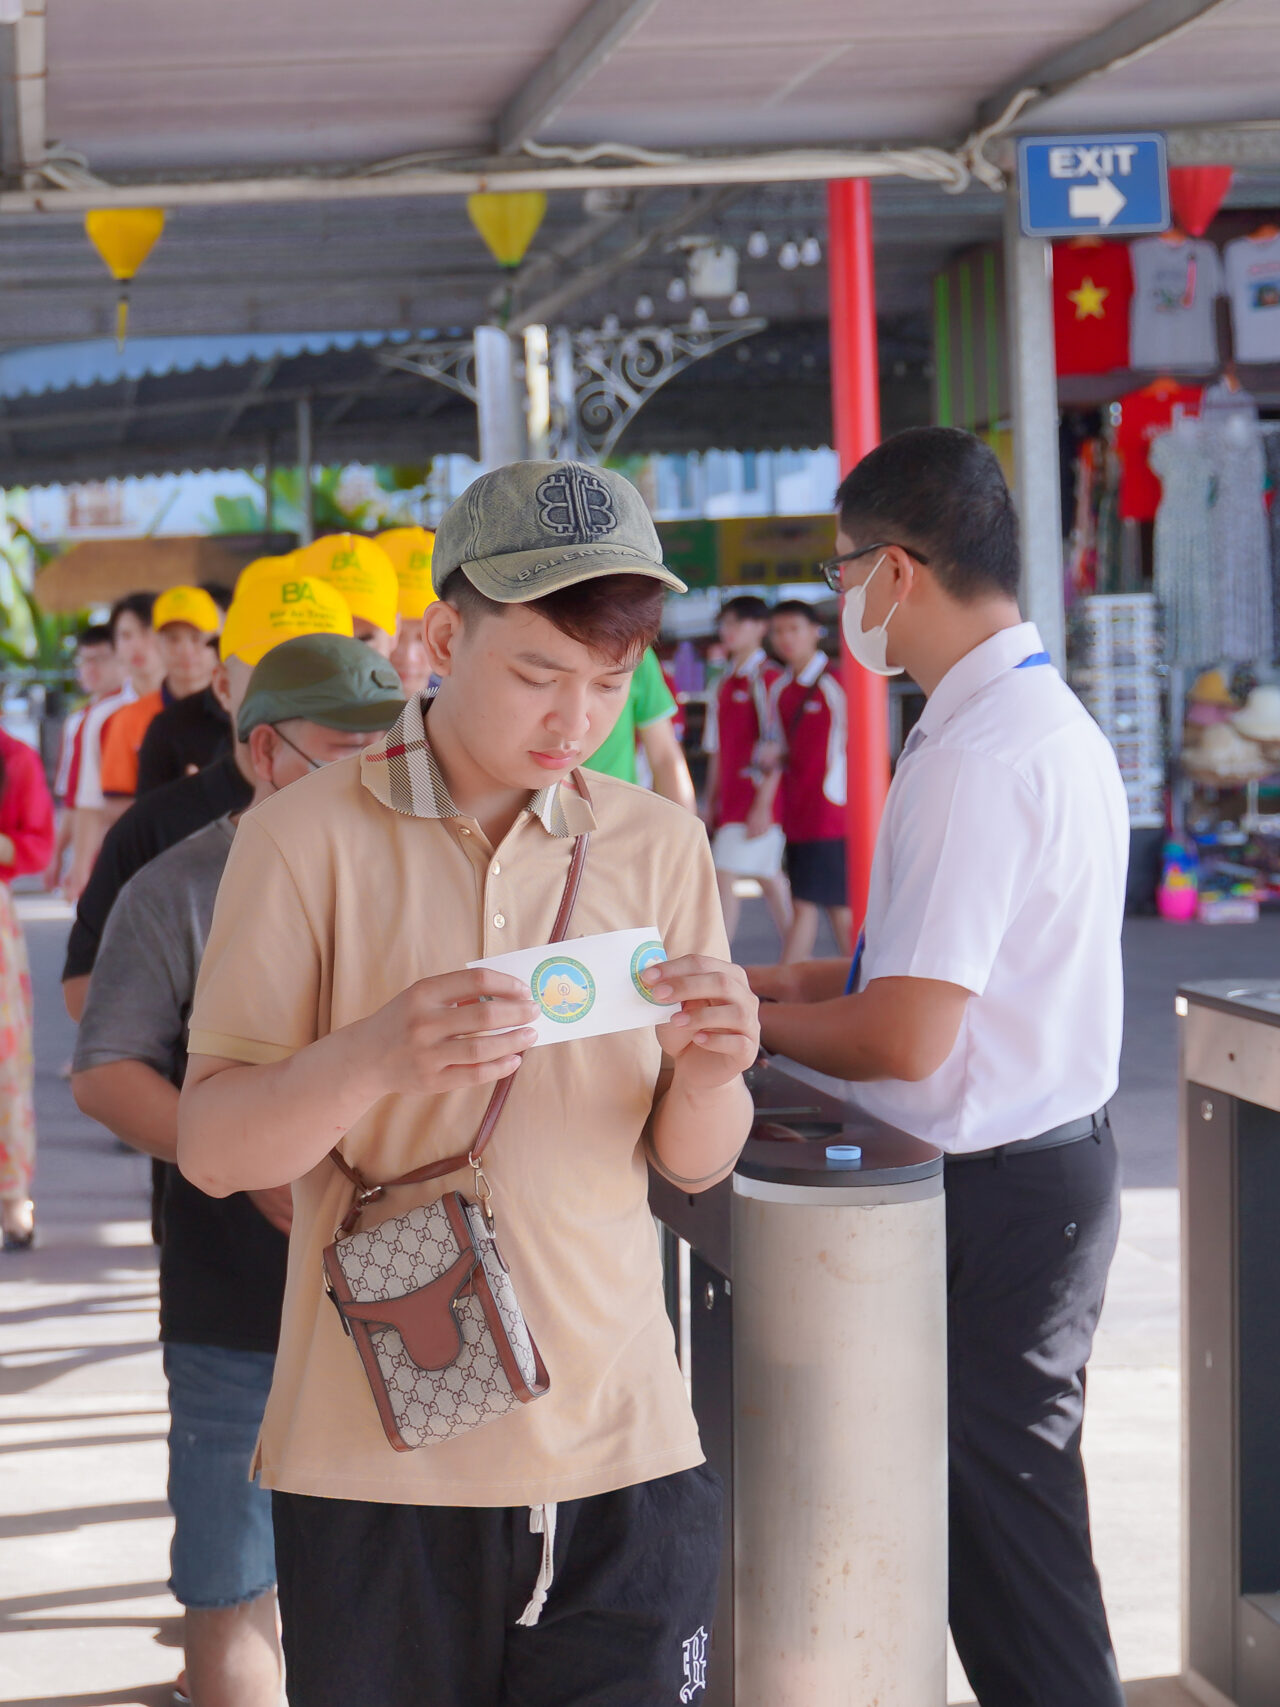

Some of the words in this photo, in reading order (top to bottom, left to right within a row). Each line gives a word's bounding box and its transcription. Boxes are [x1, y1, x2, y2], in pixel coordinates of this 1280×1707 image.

[1048, 144, 1139, 179] EXIT
[516, 548, 654, 581] BALENCIA
[282, 582, 318, 604] BA
